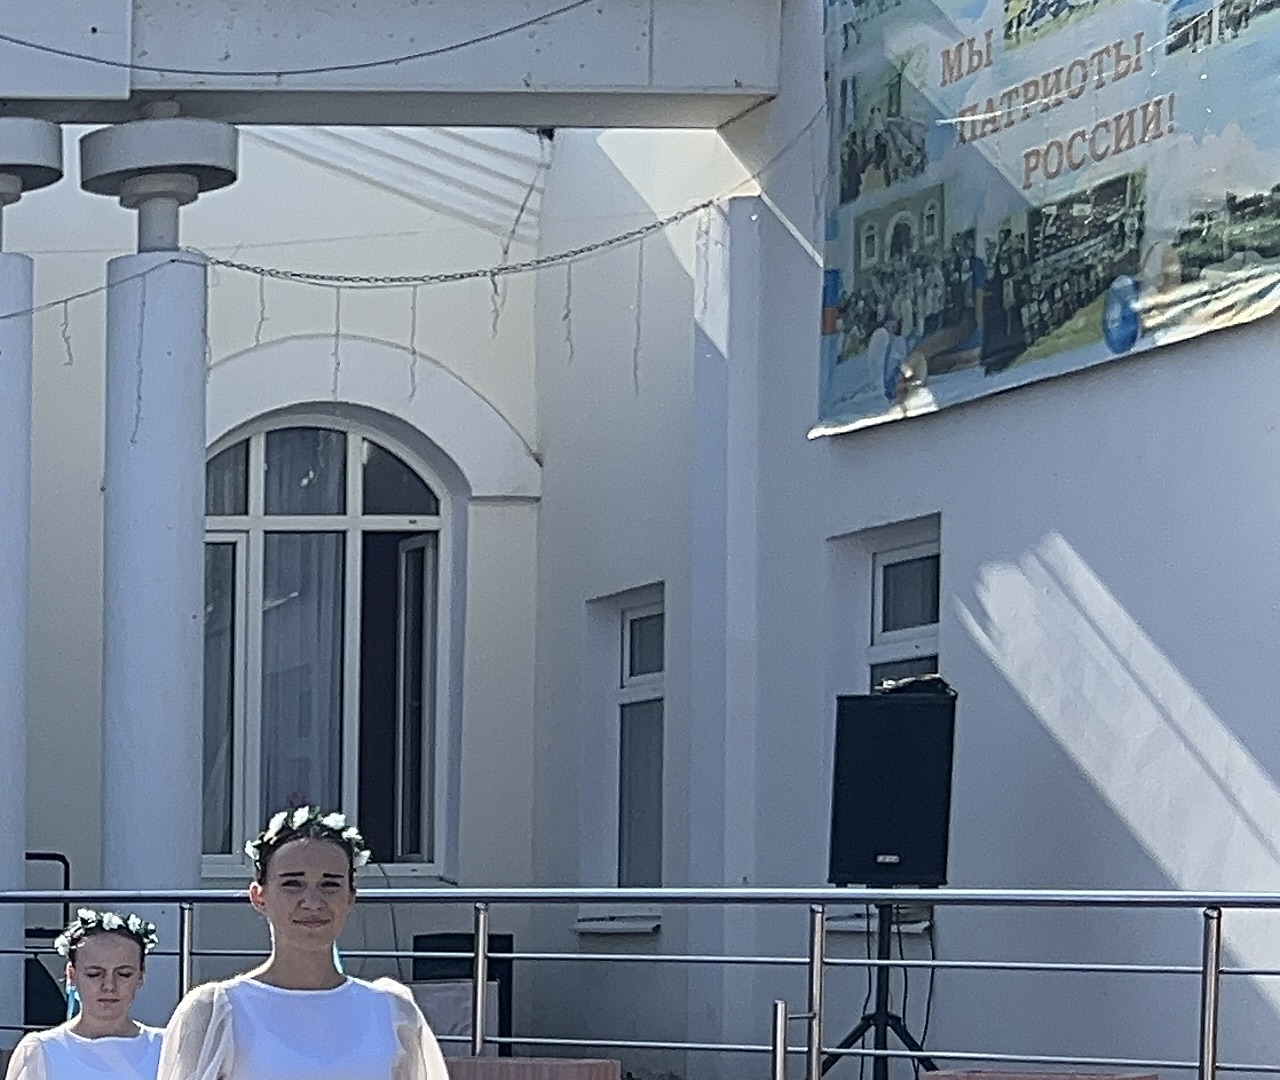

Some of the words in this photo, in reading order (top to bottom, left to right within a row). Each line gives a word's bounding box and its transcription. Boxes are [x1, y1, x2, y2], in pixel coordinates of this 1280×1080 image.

[940, 29, 993, 86] МЫ
[956, 32, 1145, 145] ПАТРИОТЫ
[1022, 93, 1175, 190] РОССИИ!
